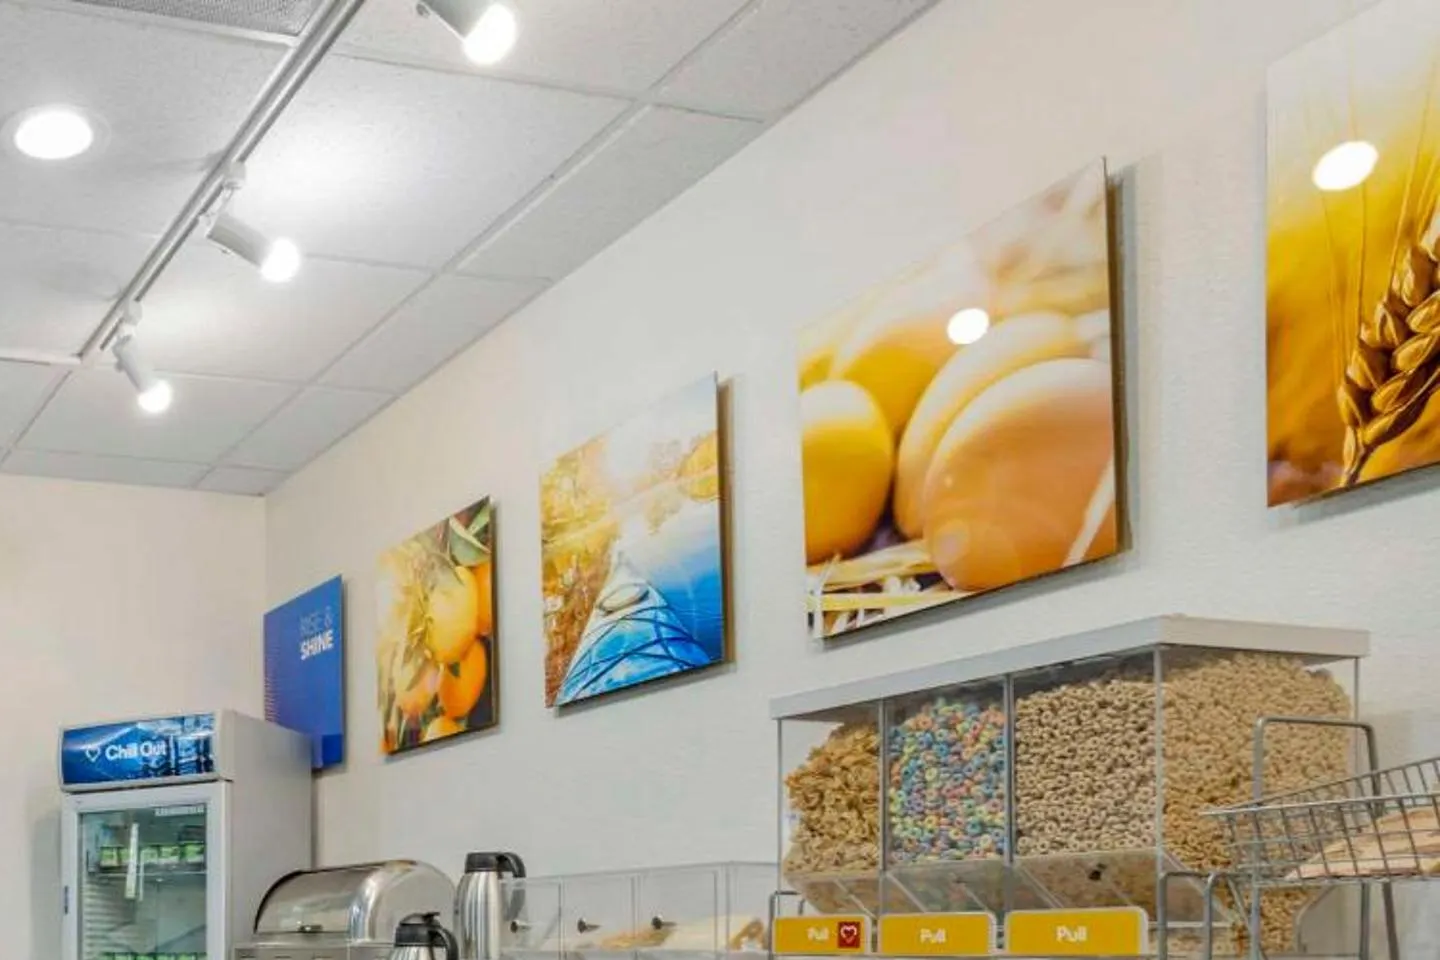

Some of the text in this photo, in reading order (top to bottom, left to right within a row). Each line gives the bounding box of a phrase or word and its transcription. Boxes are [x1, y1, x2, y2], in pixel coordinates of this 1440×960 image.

[300, 629, 334, 660] SHINE
[105, 739, 167, 761] Chill Out
[919, 927, 947, 944] Pull
[1055, 925, 1088, 943] Pull
